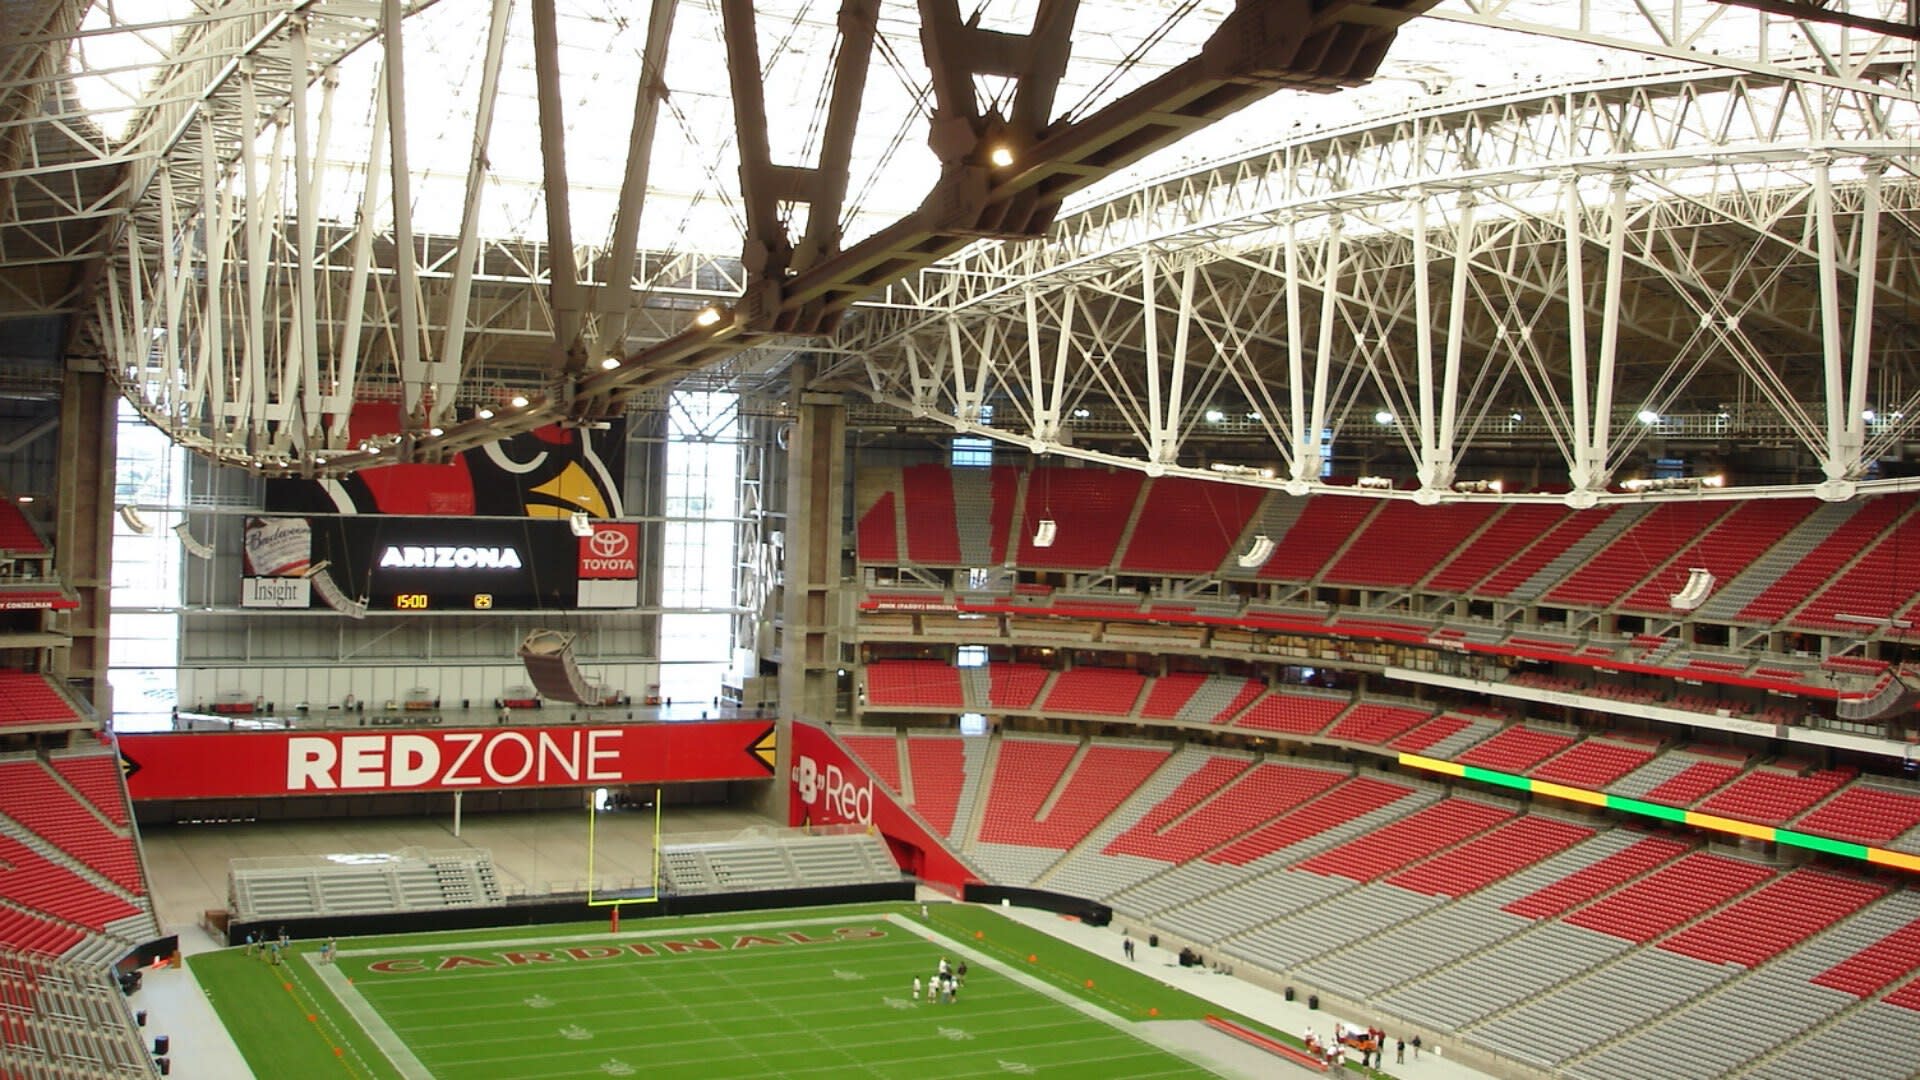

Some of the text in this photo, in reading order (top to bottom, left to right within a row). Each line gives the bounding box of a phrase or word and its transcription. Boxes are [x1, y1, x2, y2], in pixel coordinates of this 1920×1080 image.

[380, 547, 522, 568] ARIZONA
[583, 559, 634, 570] TOYOTA
[254, 579, 297, 606] Insight
[397, 594, 428, 609] 15:00
[368, 926, 888, 974] CARDINALS
